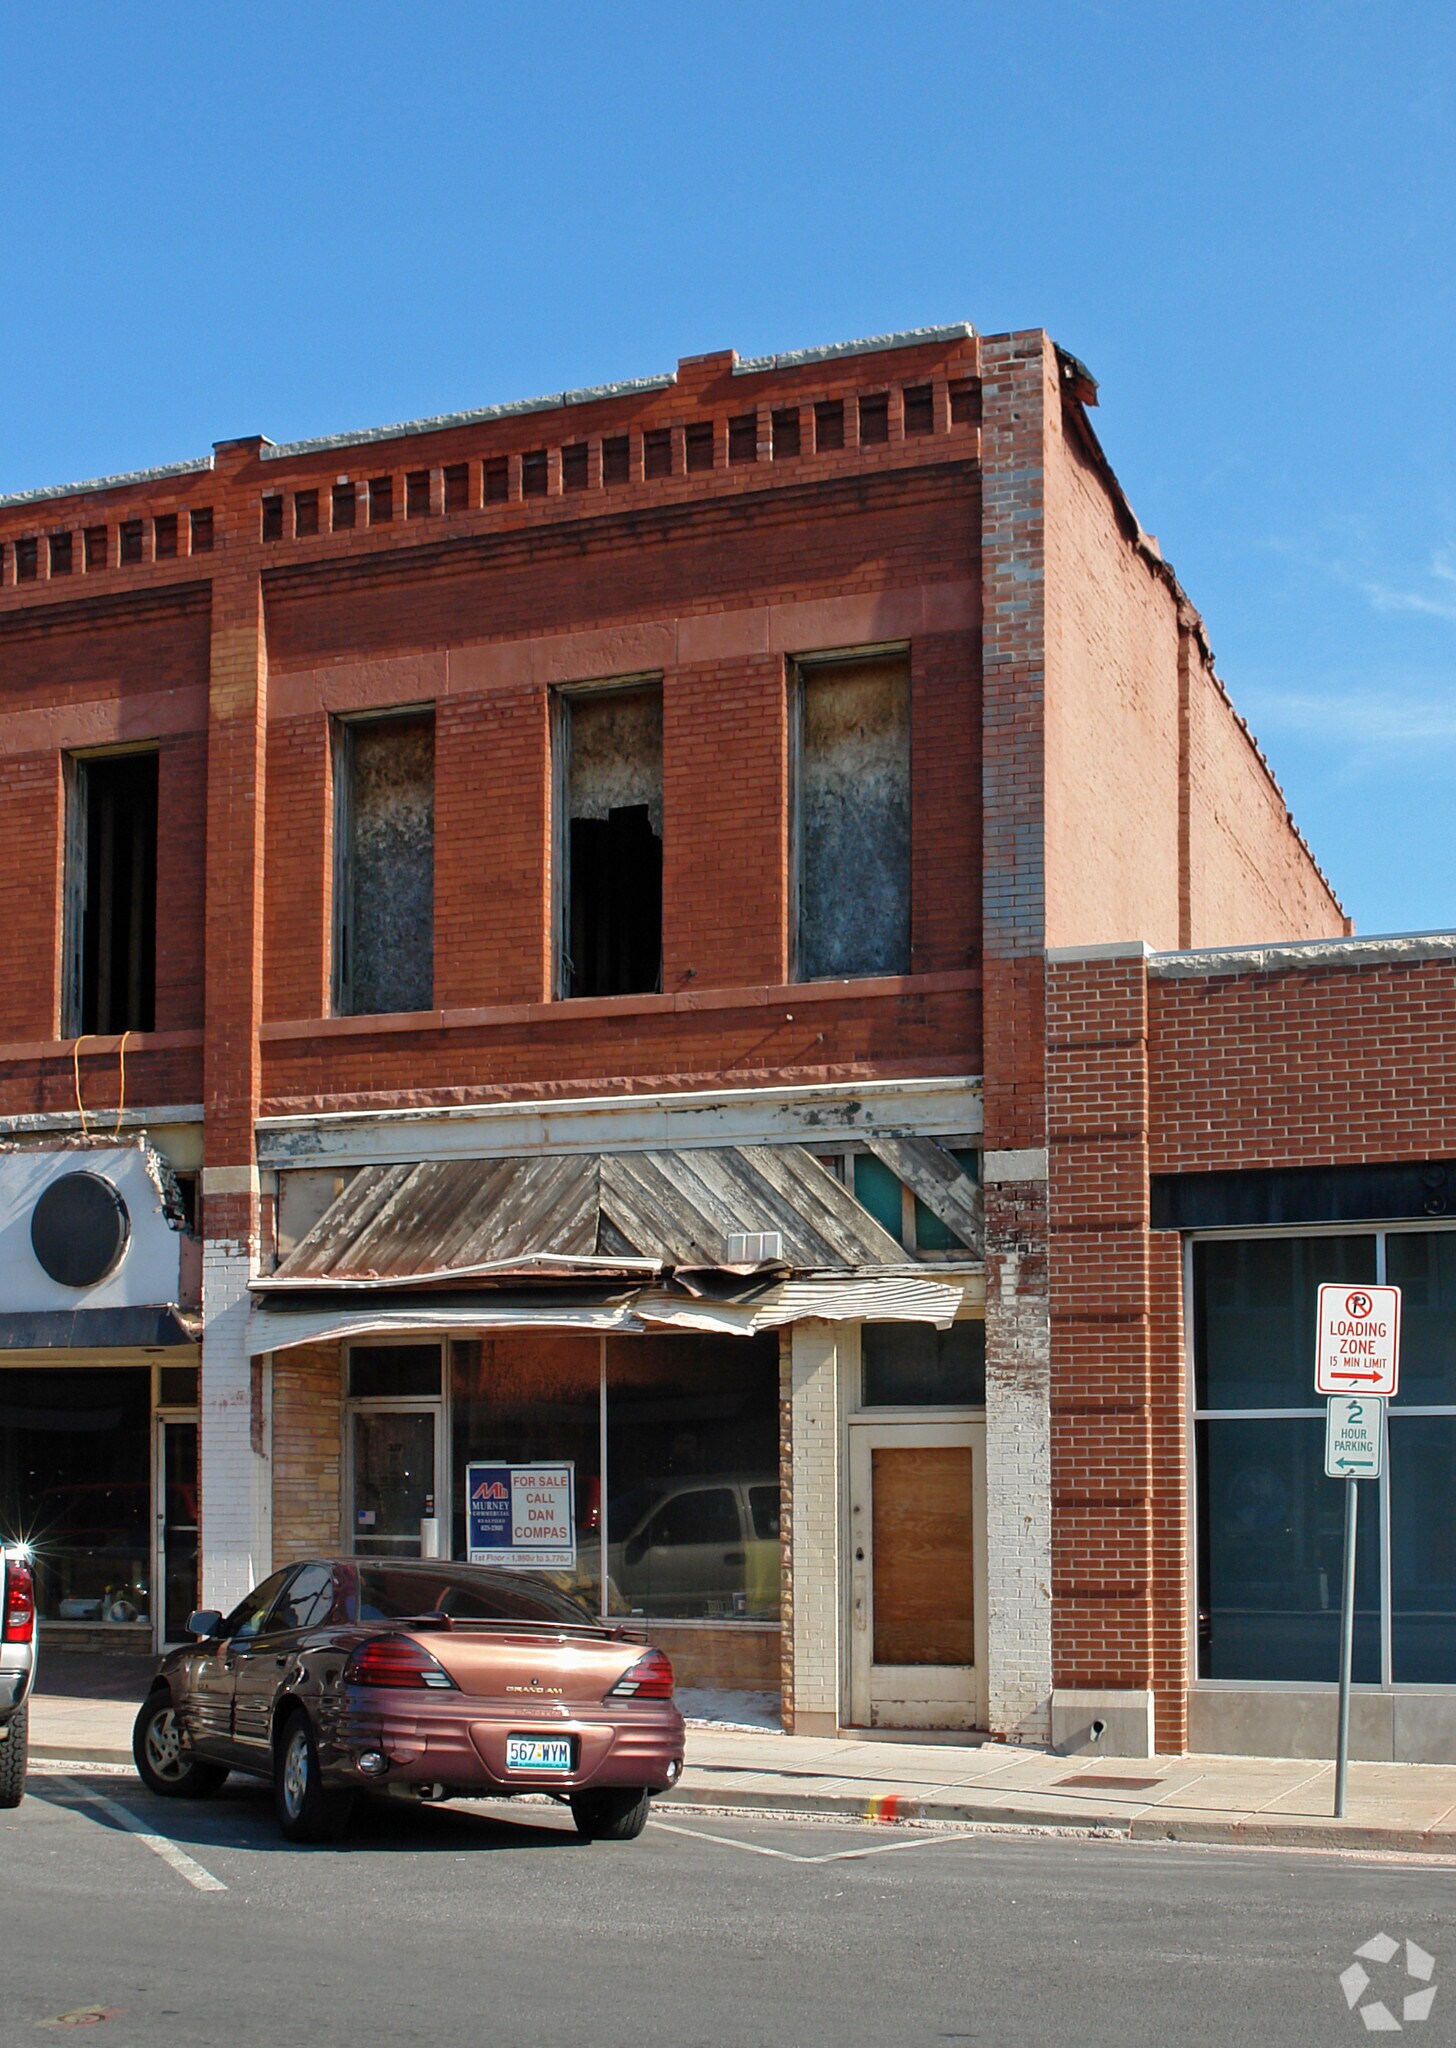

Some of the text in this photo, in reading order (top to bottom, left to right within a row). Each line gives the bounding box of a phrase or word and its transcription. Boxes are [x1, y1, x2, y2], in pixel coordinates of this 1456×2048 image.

[1330, 1320, 1387, 1337] LOADING
[1339, 1339, 1376, 1355] ZONE
[1329, 1355, 1387, 1369] 15 MIN LIMIT
[1347, 1404, 1363, 1424] 2
[1341, 1428, 1367, 1439] HOUR
[1334, 1441, 1373, 1452] PARKING
[513, 1476, 567, 1487] FOR SALE
[526, 1493, 555, 1504] CALL
[472, 1501, 510, 1510] MURNEY
[528, 1509, 554, 1521] DAN
[514, 1527, 568, 1538] COMPAS
[511, 1743, 567, 1762] 567 WYM
